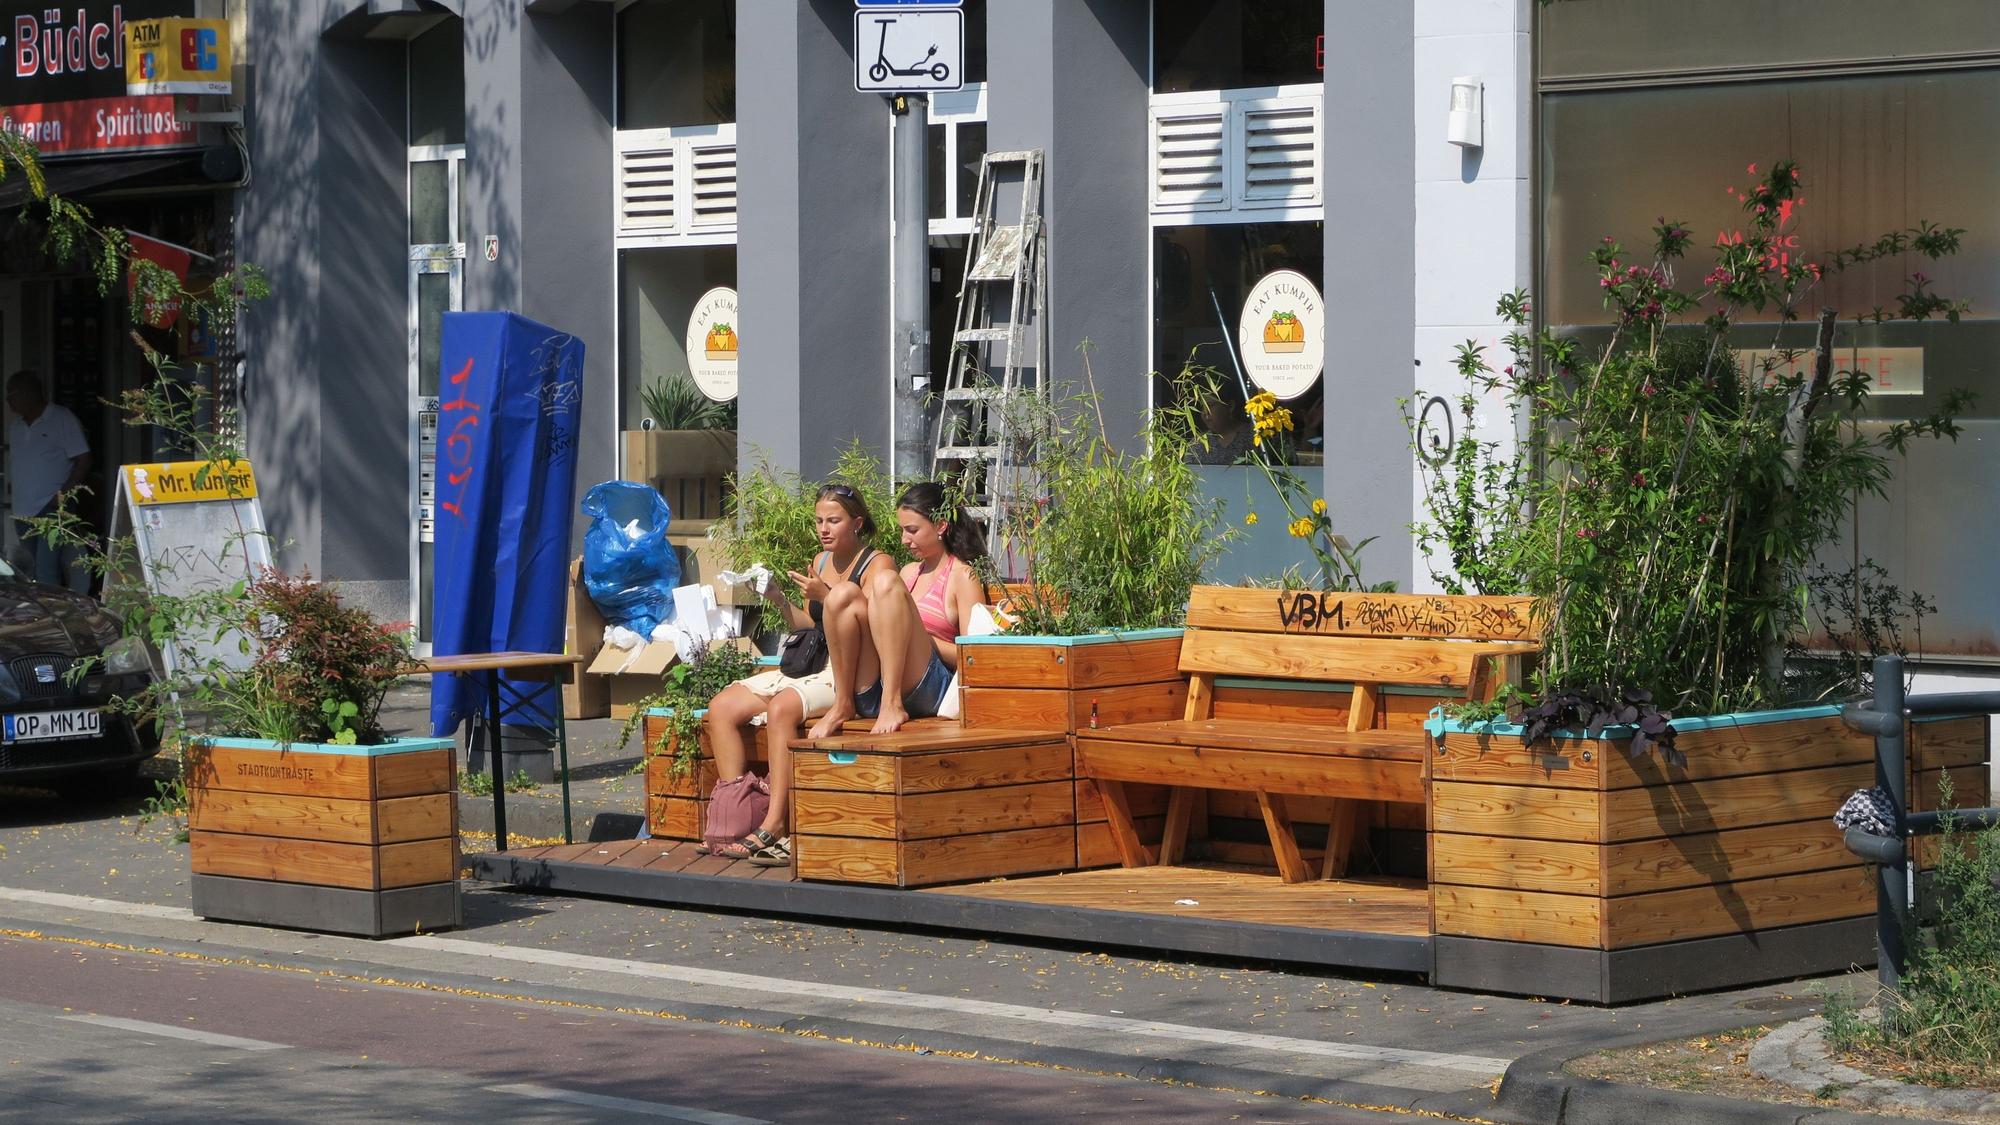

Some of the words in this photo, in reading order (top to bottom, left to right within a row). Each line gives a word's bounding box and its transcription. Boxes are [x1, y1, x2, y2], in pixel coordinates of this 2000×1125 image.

[132, 24, 160, 42] ATM
[1254, 290, 1270, 315] EAT
[1274, 283, 1315, 315] KUMPIR
[697, 303, 712, 326] EAT
[1292, 363, 1314, 371] POTATO
[158, 474, 188, 493] Mr.
[16, 716, 39, 735] OP
[50, 713, 73, 733] MN
[77, 711, 98, 730] 10
